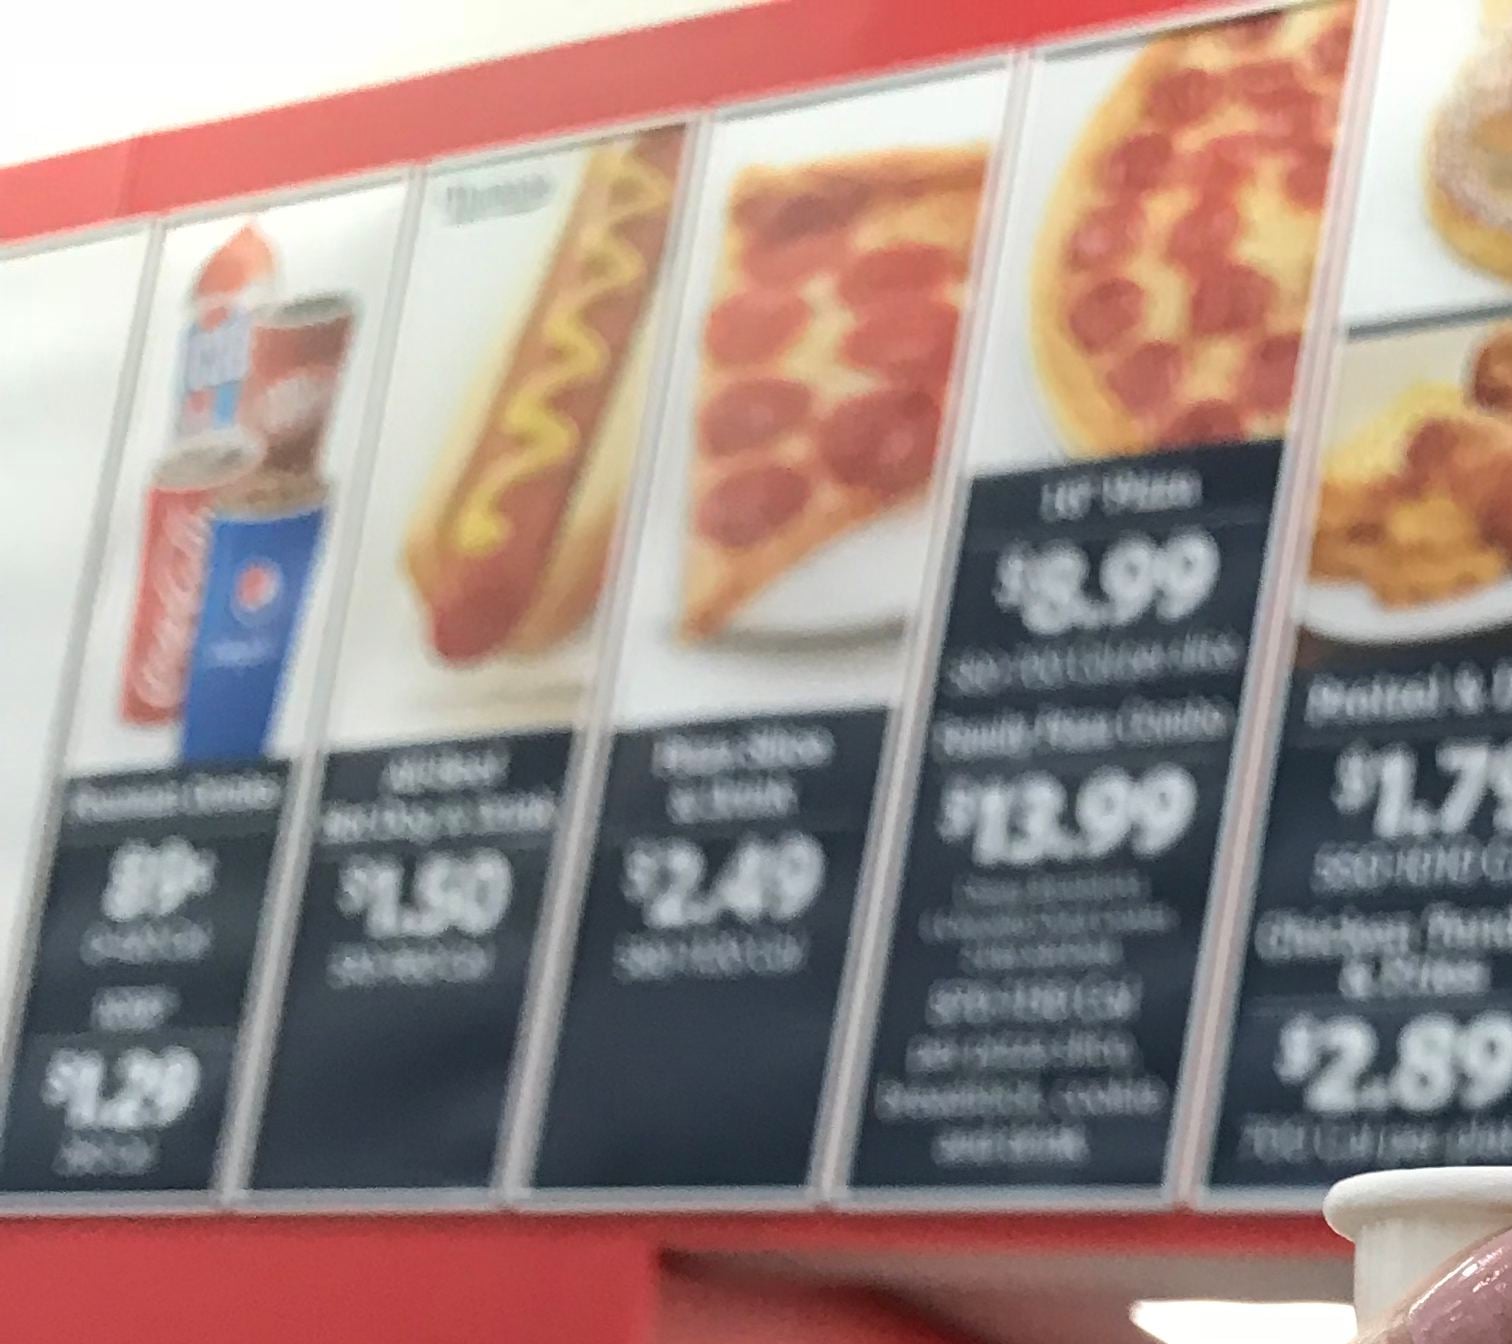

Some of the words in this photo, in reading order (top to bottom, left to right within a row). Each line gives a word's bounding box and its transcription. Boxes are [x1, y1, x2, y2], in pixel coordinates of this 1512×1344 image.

[995, 524, 1221, 636] $8.99
[935, 762, 1198, 869] $13.99
[621, 832, 825, 928] $2.49
